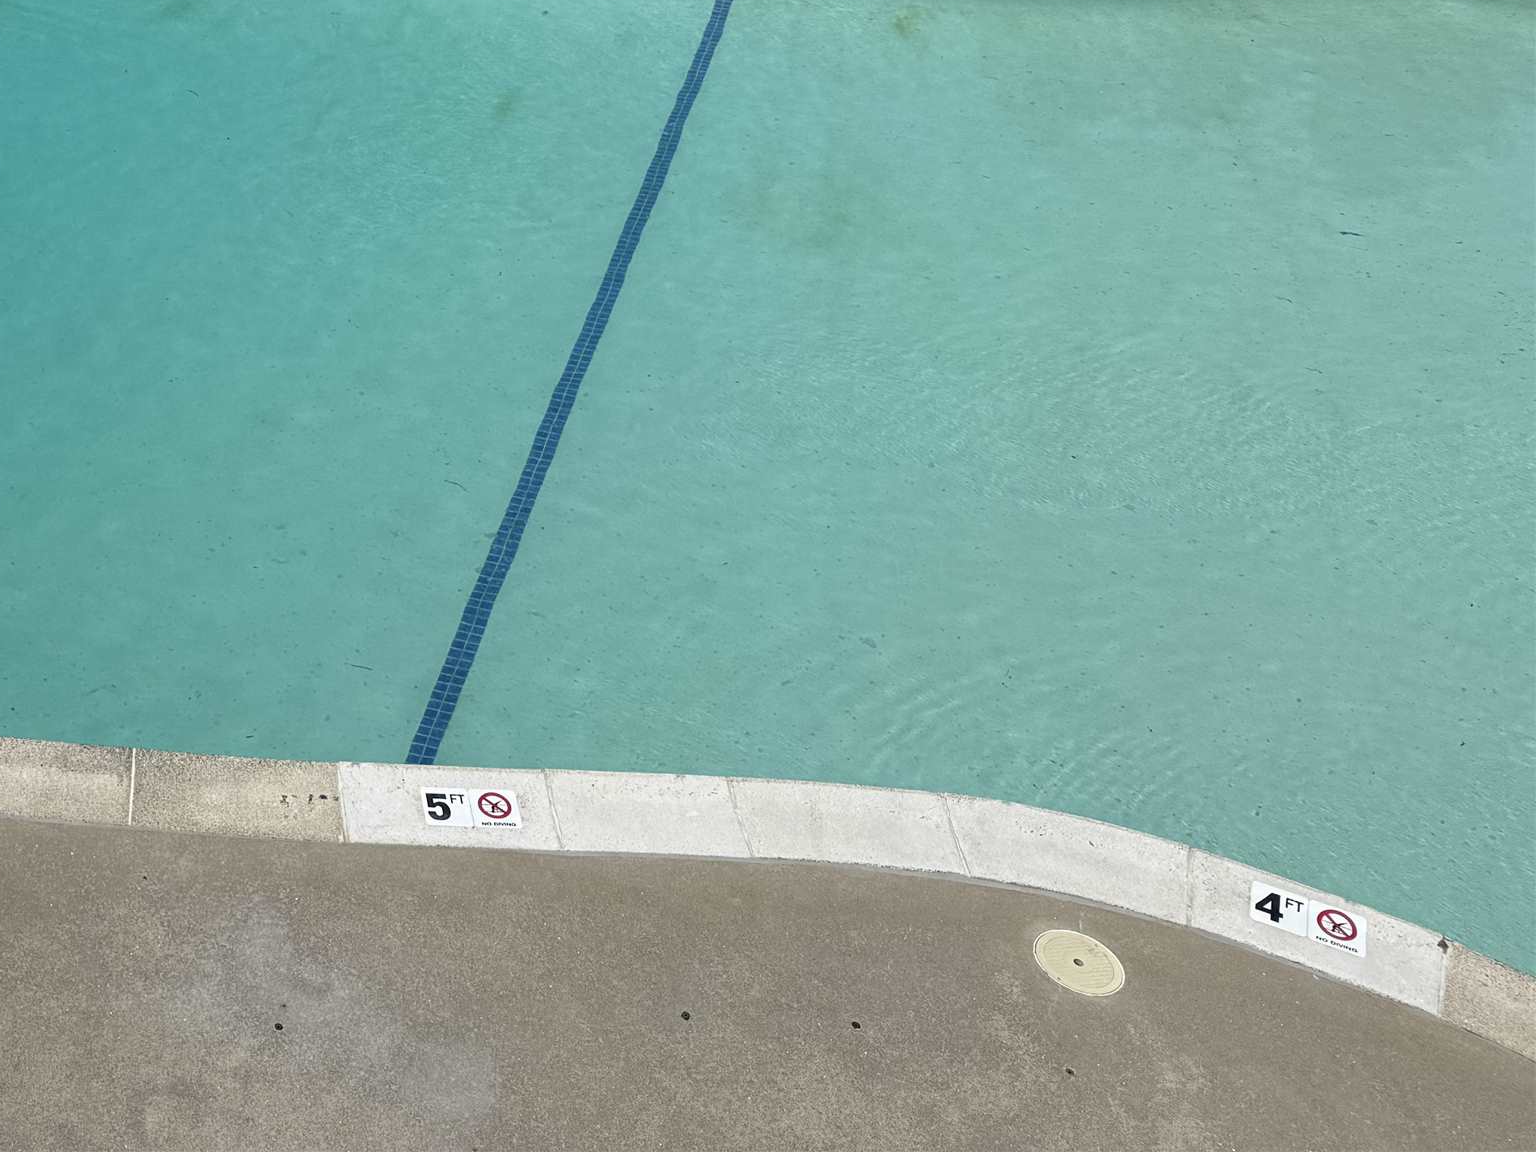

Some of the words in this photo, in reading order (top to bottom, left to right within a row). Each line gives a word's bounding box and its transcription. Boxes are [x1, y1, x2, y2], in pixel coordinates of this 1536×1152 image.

[425, 793, 451, 821] 5
[449, 793, 465, 805] FT
[1255, 892, 1284, 923] 4
[1285, 897, 1305, 913] FT
